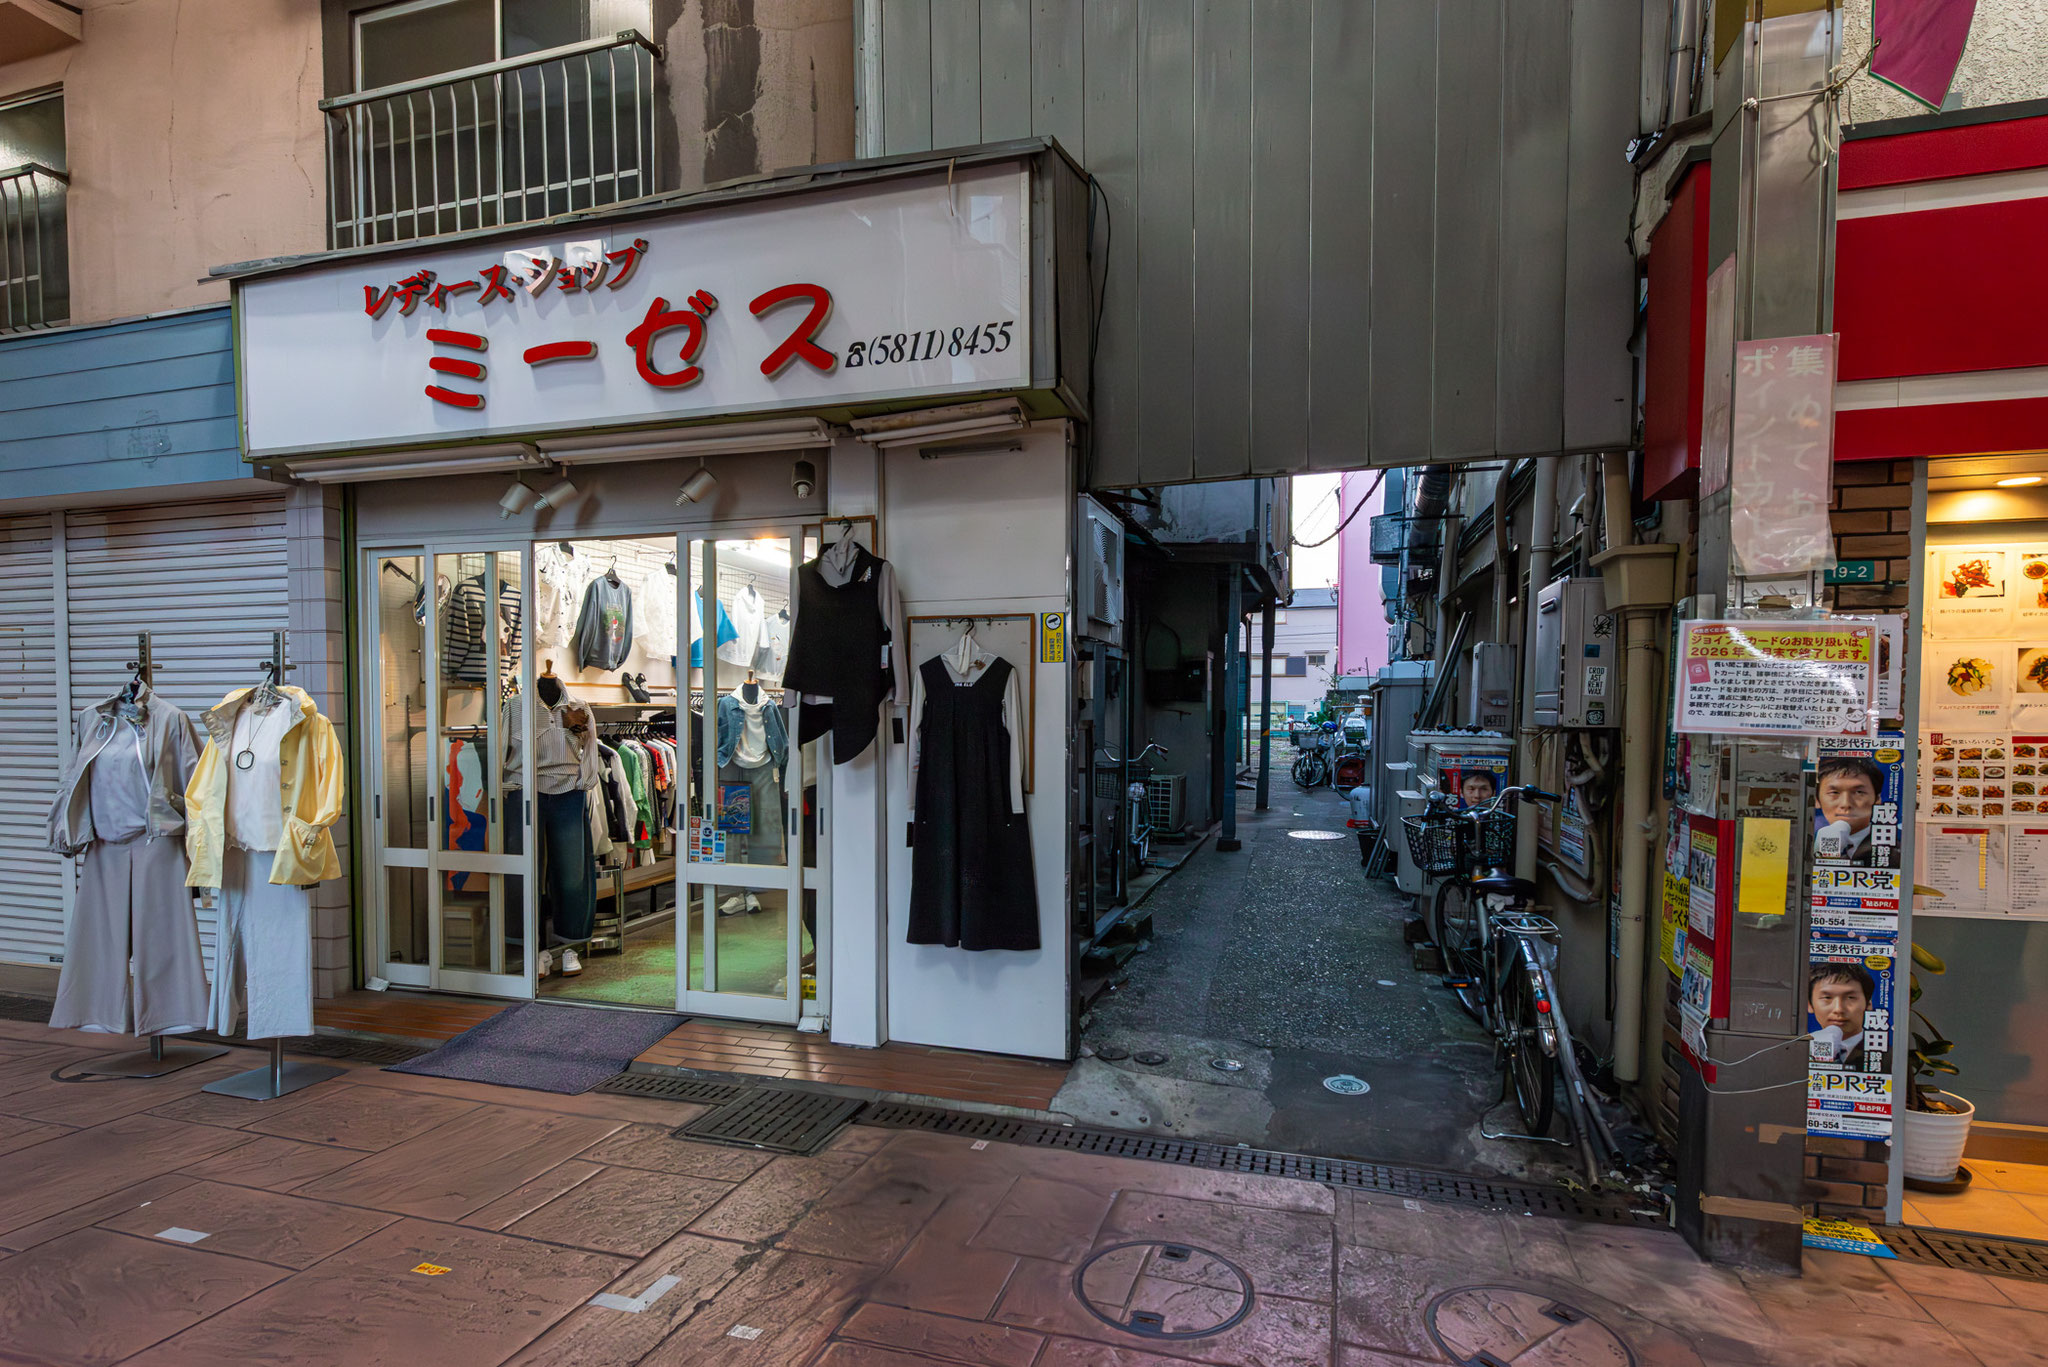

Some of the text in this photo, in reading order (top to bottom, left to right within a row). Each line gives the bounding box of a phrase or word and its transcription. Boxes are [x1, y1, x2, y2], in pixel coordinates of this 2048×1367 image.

[425, 283, 838, 410] ミーゼス
[867, 321, 1014, 366] (5811)8455
[1832, 565, 1868, 578] 19-2
[1690, 635, 1864, 648] ジョイフカードのお取り扱いは、
[1690, 647, 1868, 661] 2026年月末で終了します。
